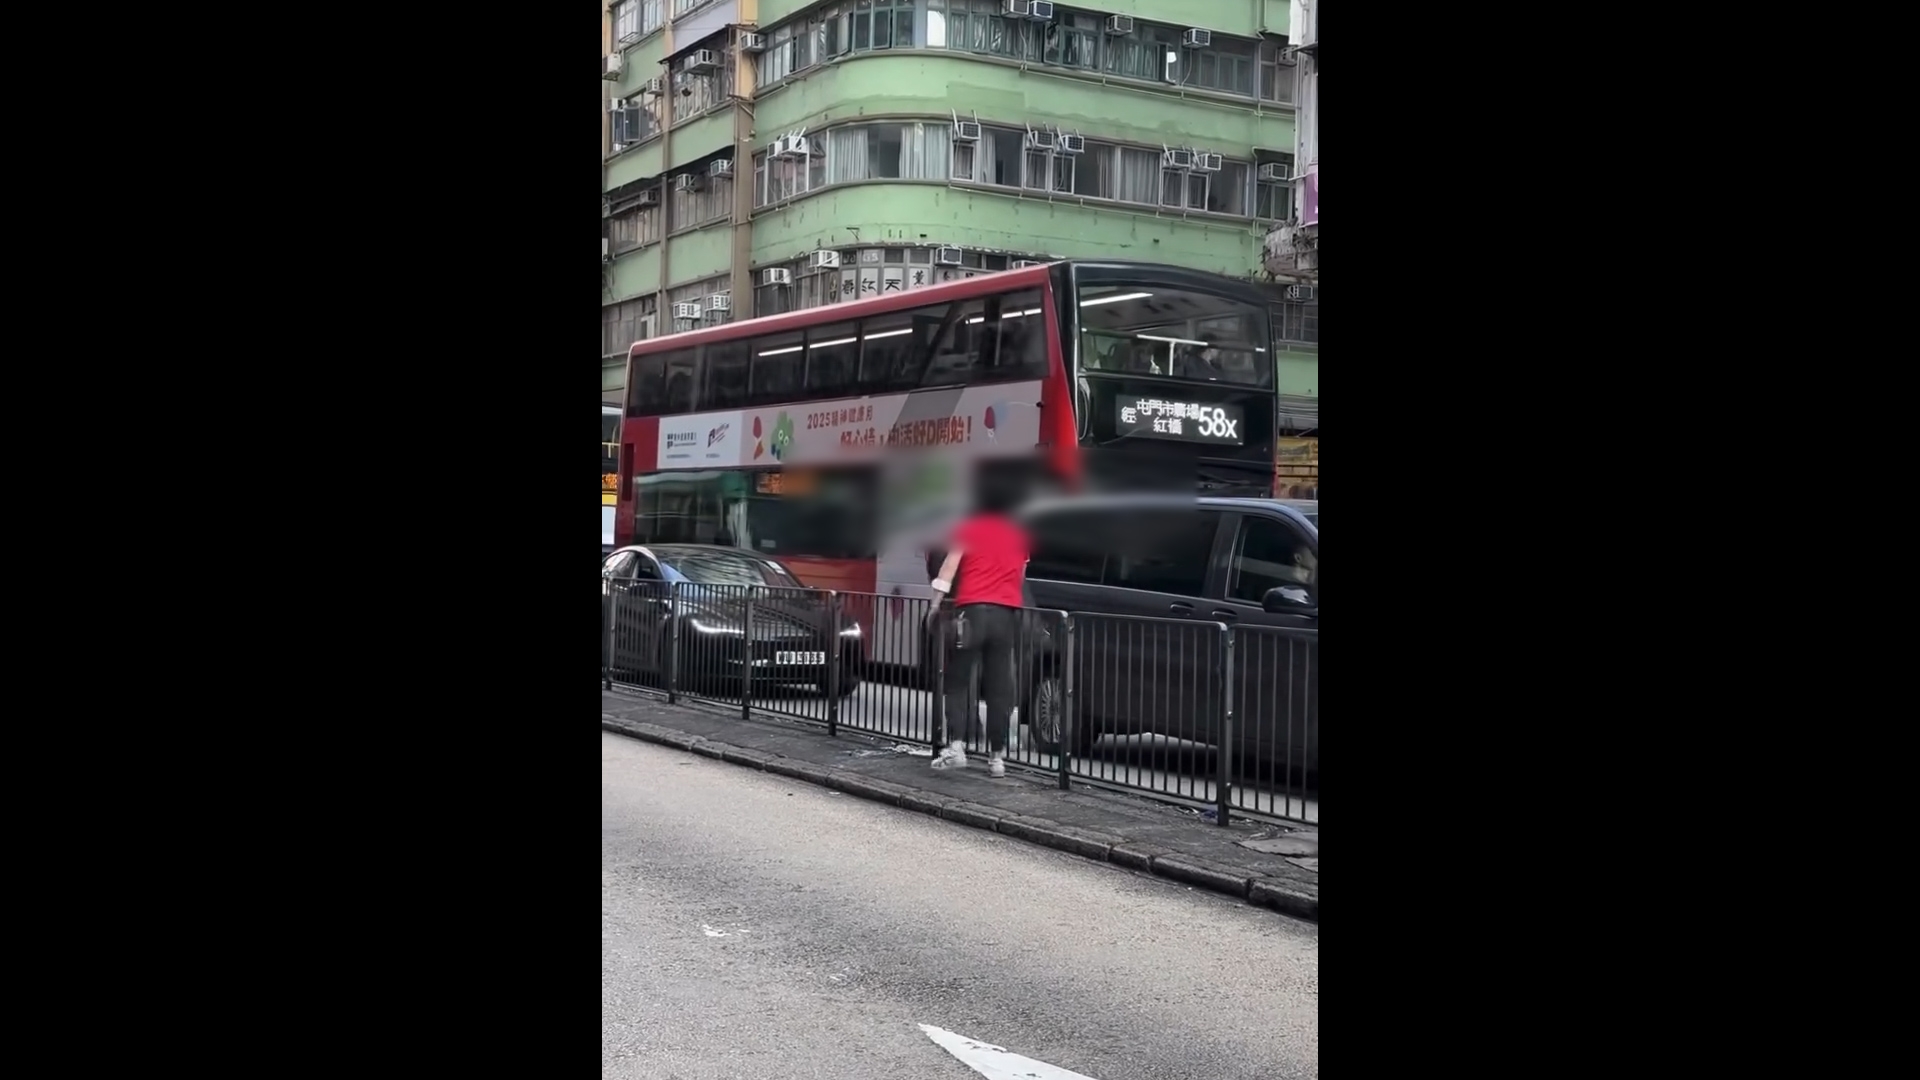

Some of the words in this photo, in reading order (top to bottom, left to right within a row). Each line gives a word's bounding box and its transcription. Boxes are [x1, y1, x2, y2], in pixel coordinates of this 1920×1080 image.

[1136, 399, 1199, 420] 屯門市廣場
[1153, 417, 1182, 434] 紅橋
